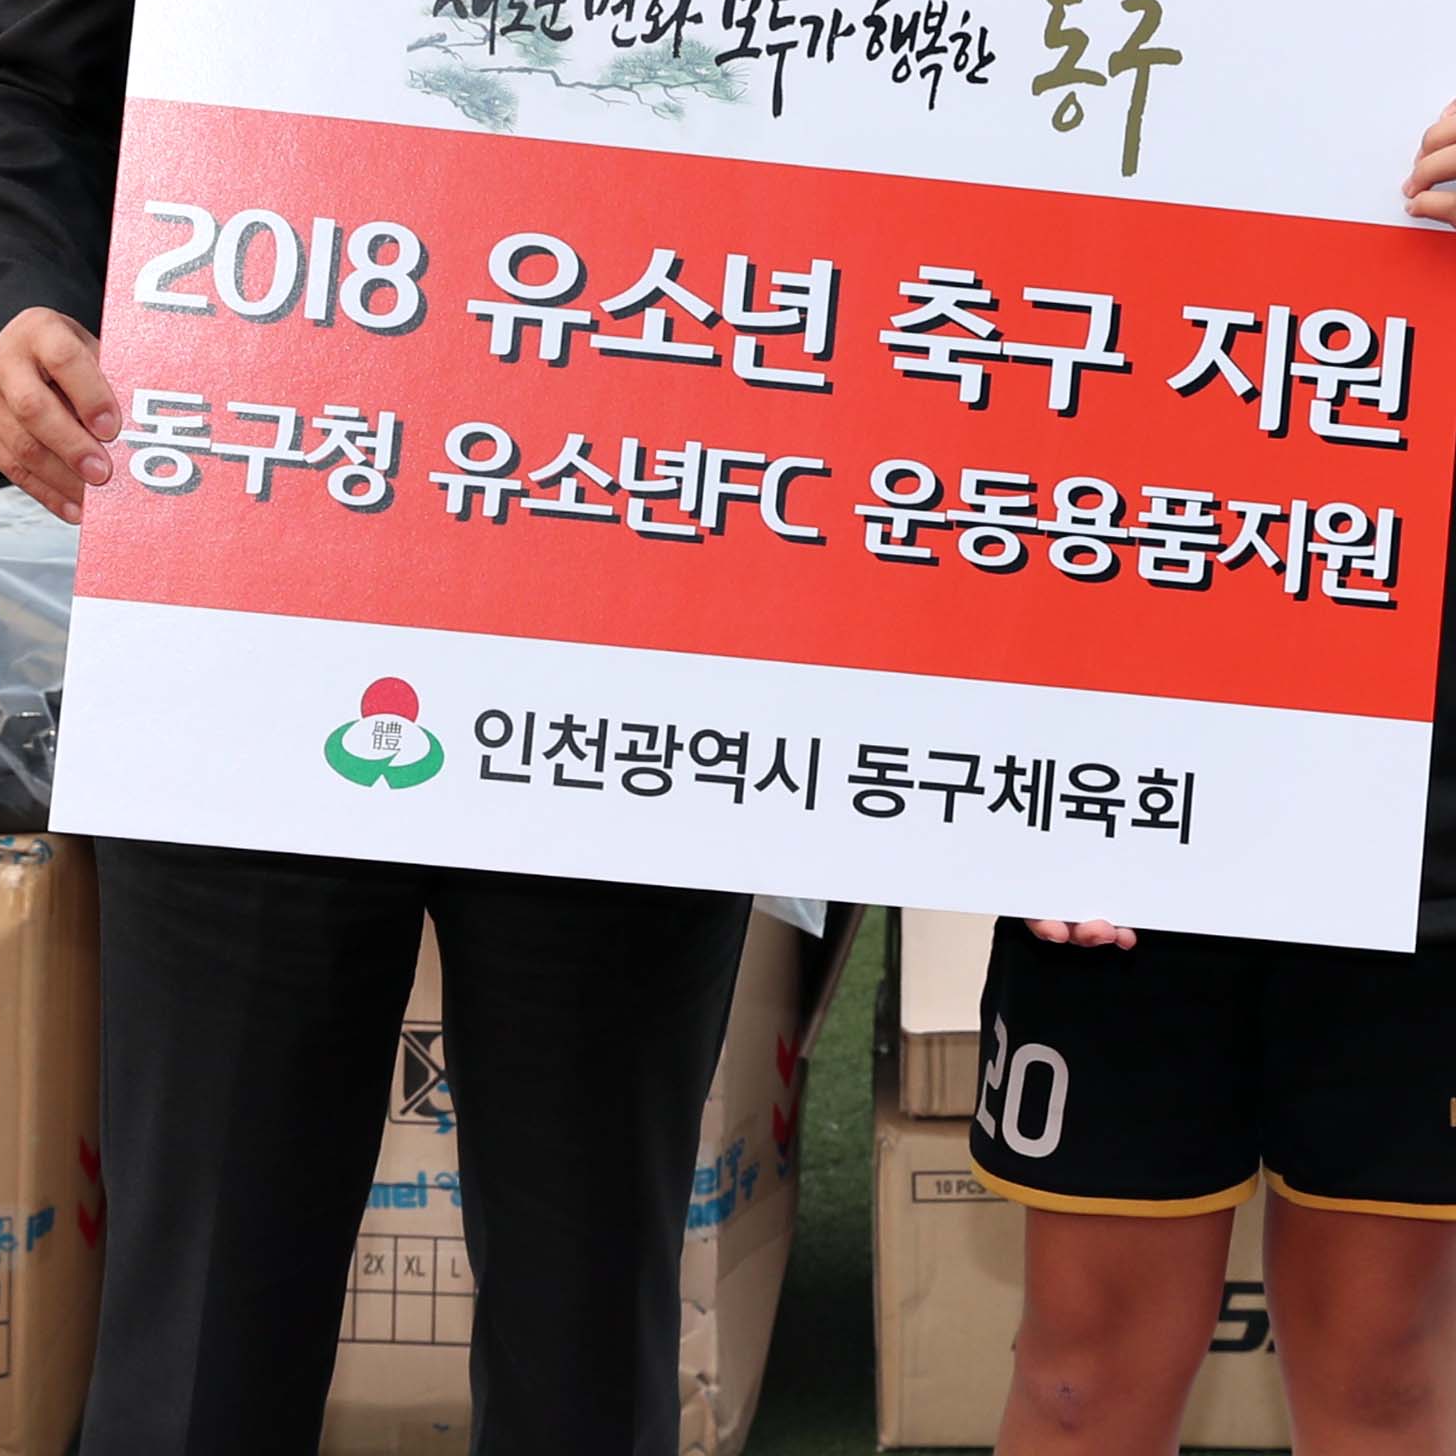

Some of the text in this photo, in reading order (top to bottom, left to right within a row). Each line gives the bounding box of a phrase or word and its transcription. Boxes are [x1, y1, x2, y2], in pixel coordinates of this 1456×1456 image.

[133, 199, 1415, 450] 2018 유소년 축구 지원
[121, 388, 1403, 609] 동구청 유소년FC 운동용품지원
[472, 707, 1198, 846] 인천광역시 동구체육회
[975, 1011, 1069, 1159] 20
[935, 1179, 953, 1195] 10
[362, 1253, 462, 1279] 2X XL L
